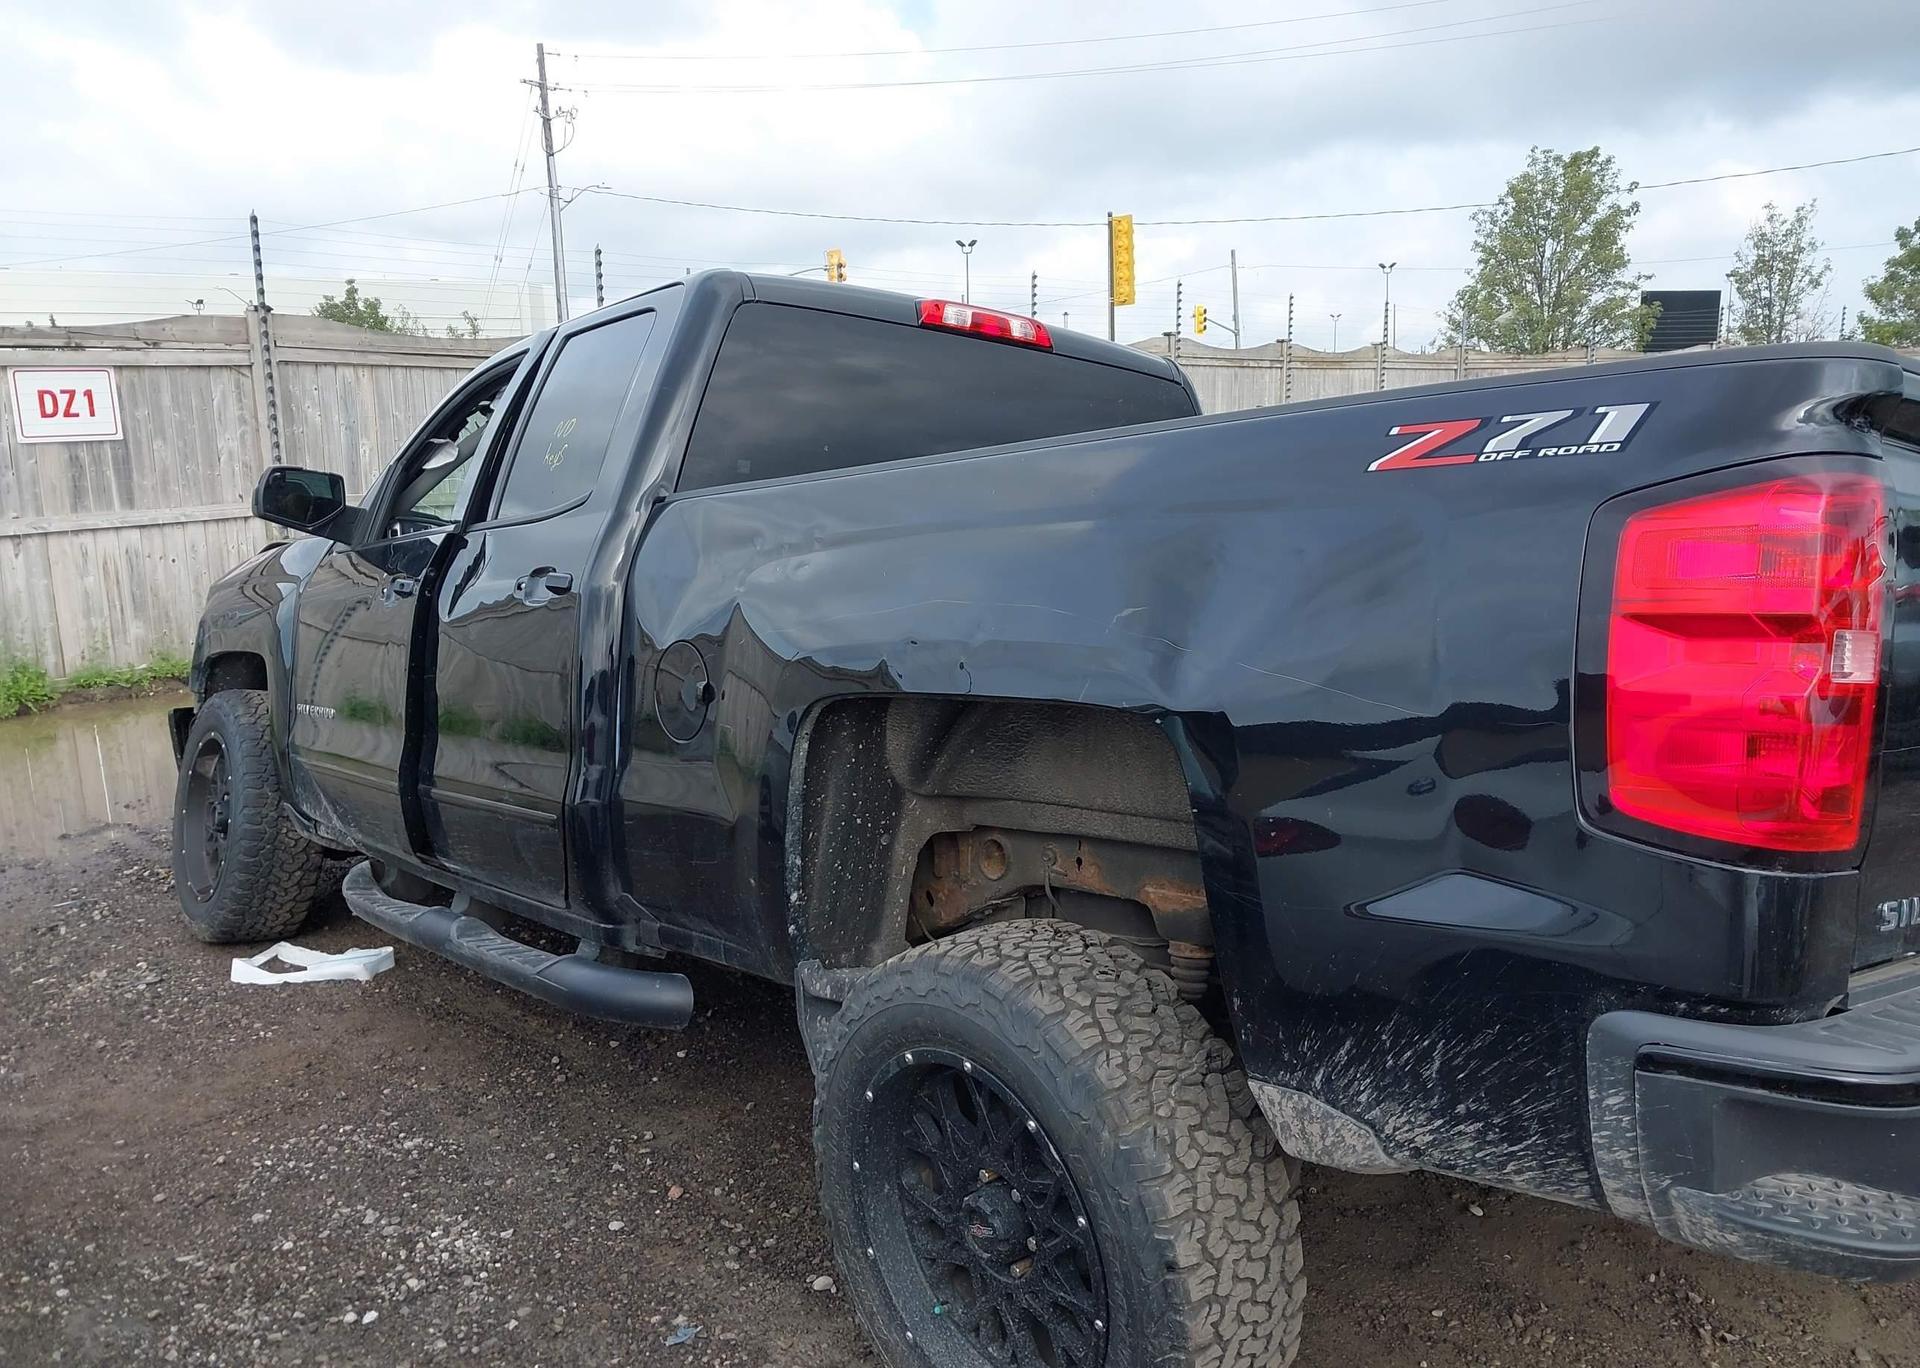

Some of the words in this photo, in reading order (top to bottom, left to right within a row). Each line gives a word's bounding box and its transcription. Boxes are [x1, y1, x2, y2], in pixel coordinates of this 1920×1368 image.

[37, 388, 96, 419] DZ1
[1366, 402, 1652, 472] Z71
[1478, 449, 1533, 462] OFF
[1538, 441, 1622, 457] ROAD
